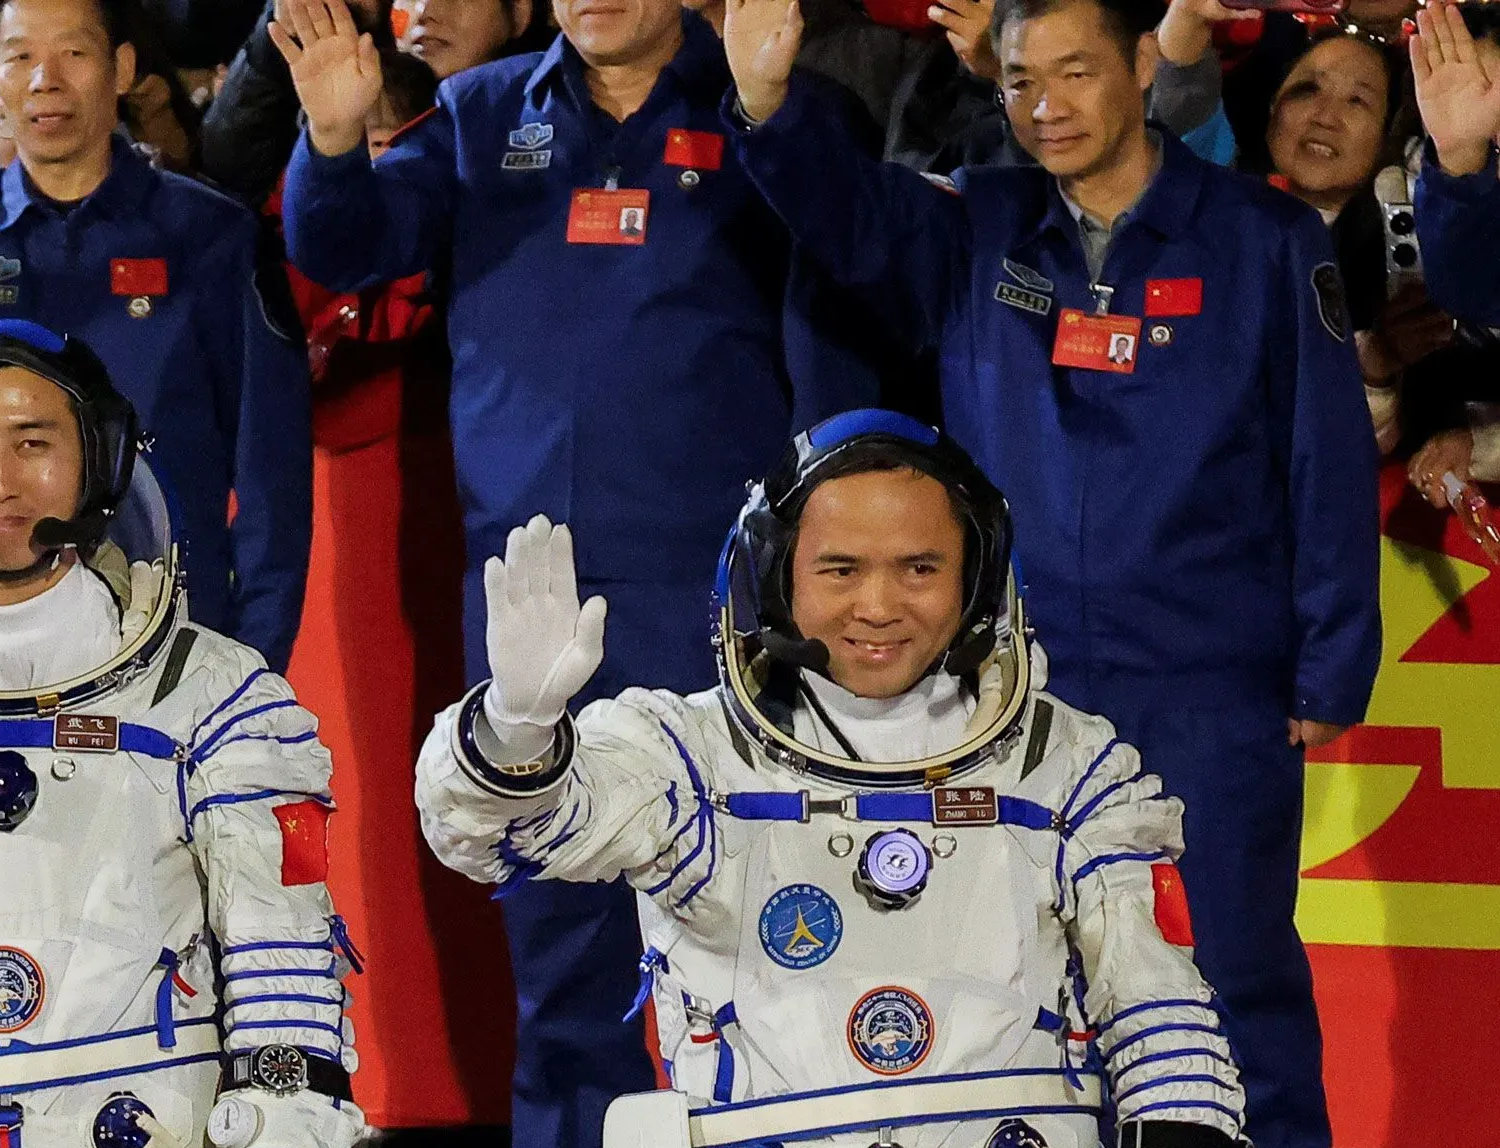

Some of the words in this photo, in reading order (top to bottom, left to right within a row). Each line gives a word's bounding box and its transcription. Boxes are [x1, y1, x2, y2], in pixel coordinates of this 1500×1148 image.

[67, 737, 79, 745] WU
[91, 737, 105, 746] FEI
[945, 810, 967, 818] ZHANG
